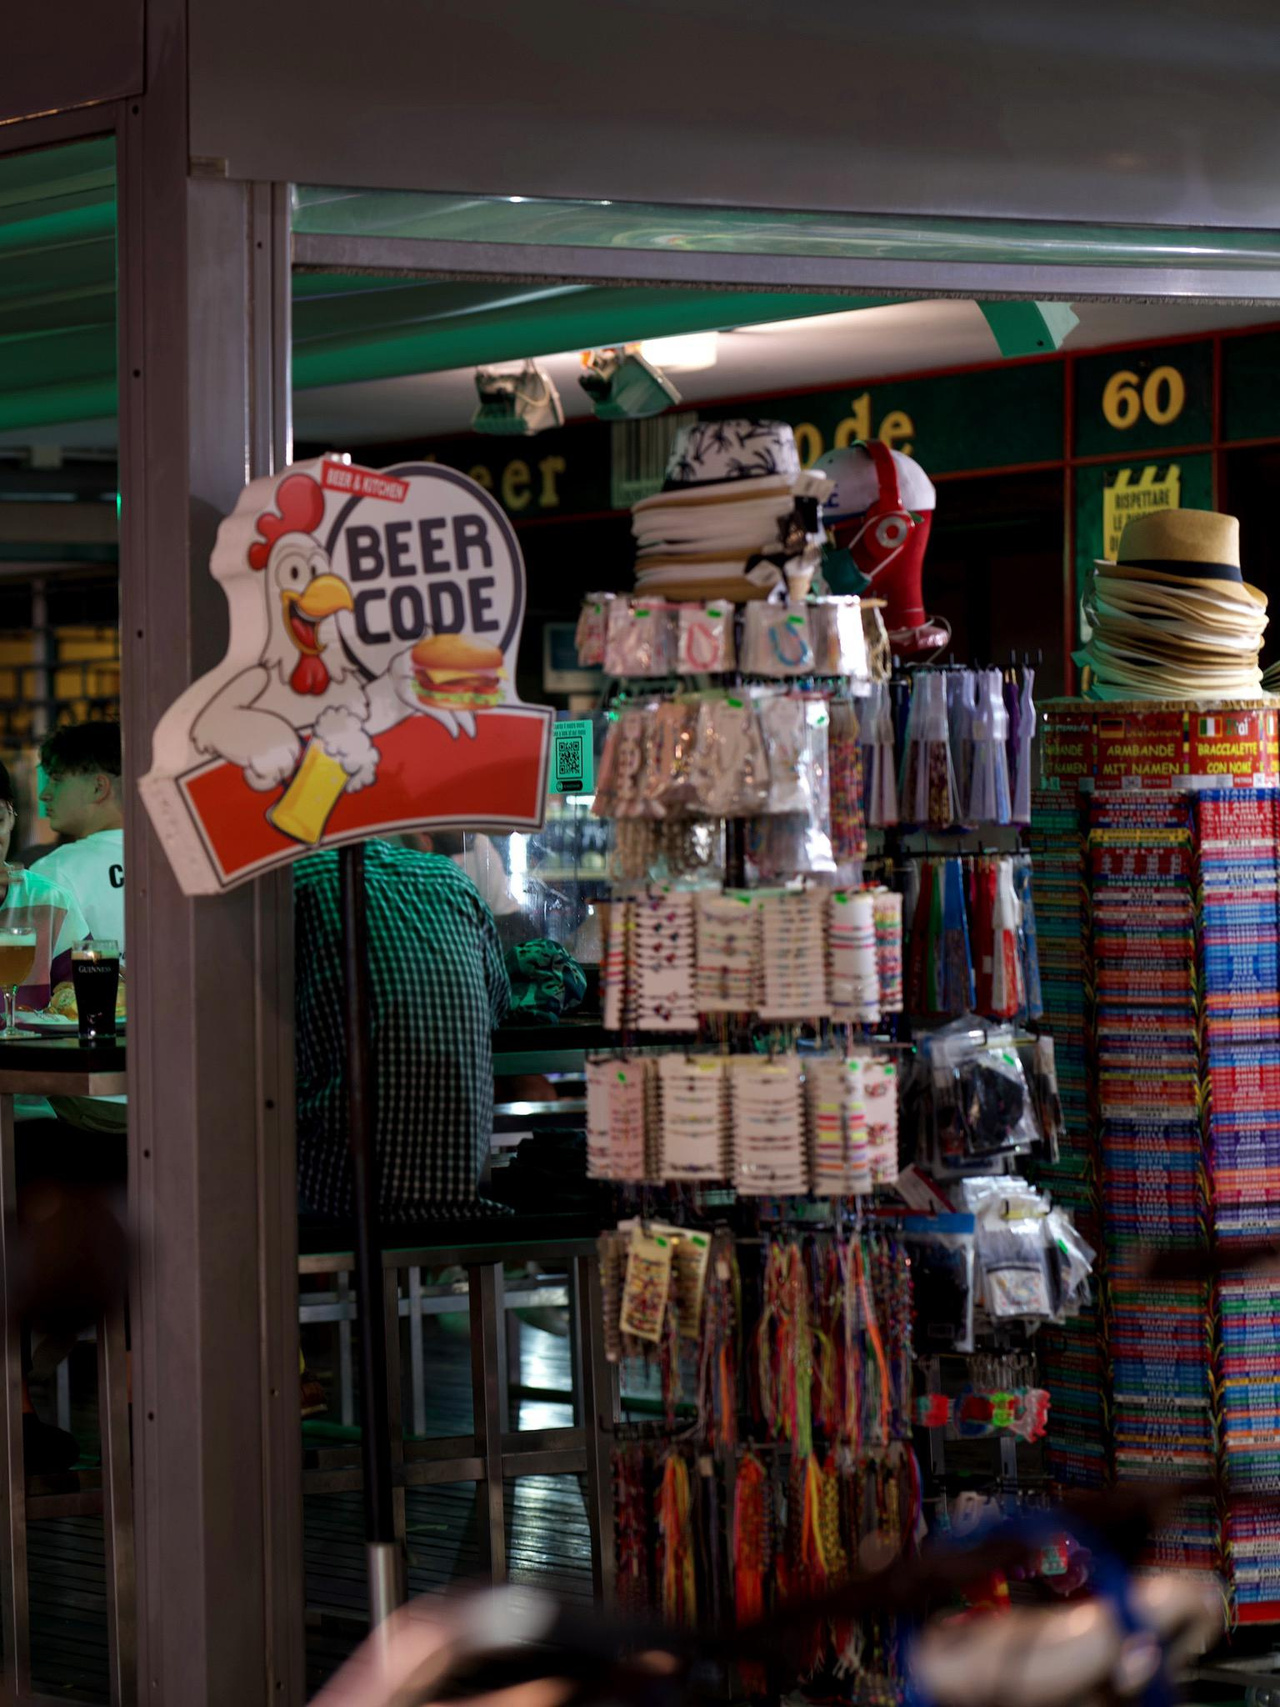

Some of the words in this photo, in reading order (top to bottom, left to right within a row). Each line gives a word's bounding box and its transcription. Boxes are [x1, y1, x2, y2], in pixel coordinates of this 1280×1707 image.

[1102, 365, 1187, 431] 60
[465, 454, 568, 512] eer
[794, 392, 916, 472] ode
[327, 468, 353, 488] BEER
[362, 476, 403, 499] KITCHEN
[1115, 488, 1170, 510] RISPETTARE
[345, 514, 492, 582] BEER
[354, 577, 499, 645] CODE
[1102, 763, 1128, 775] MIT
[1131, 762, 1180, 775] NAMEN
[1207, 762, 1227, 774] CON
[78, 964, 112, 975] GUINNESS
